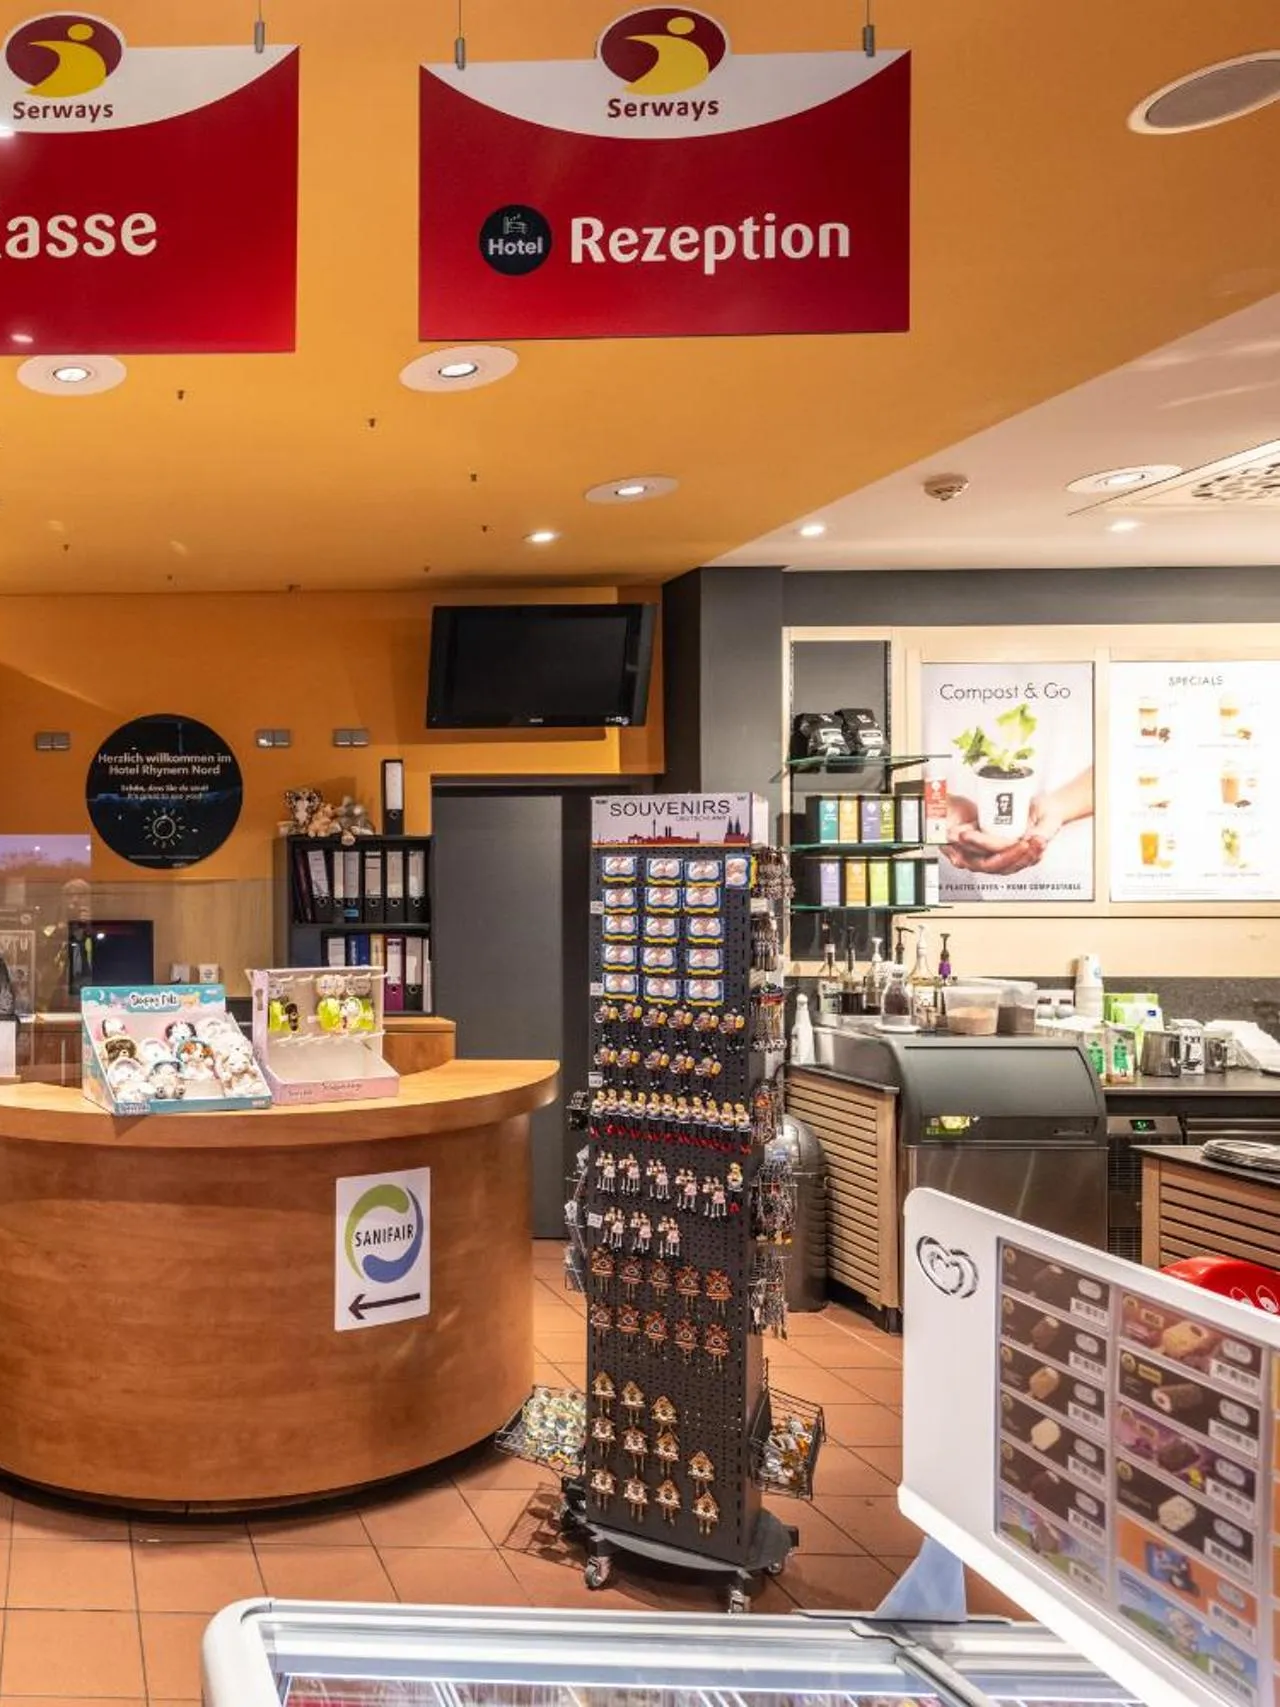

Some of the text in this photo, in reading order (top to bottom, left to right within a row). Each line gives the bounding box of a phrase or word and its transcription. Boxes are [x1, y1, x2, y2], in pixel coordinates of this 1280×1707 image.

[13, 101, 113, 122] Serways
[607, 98, 719, 120] Serways
[487, 236, 543, 256] Hotel
[570, 213, 851, 275] Rezeption
[1168, 675, 1224, 687] SPECIALS
[939, 682, 1071, 703] Compost & Go
[98, 753, 231, 763] Herzlich willkommen im
[109, 764, 220, 777] Hotel Rhynern Nord
[610, 800, 731, 817] SOUVENIRS
[355, 1223, 414, 1247] SANIFAIR
